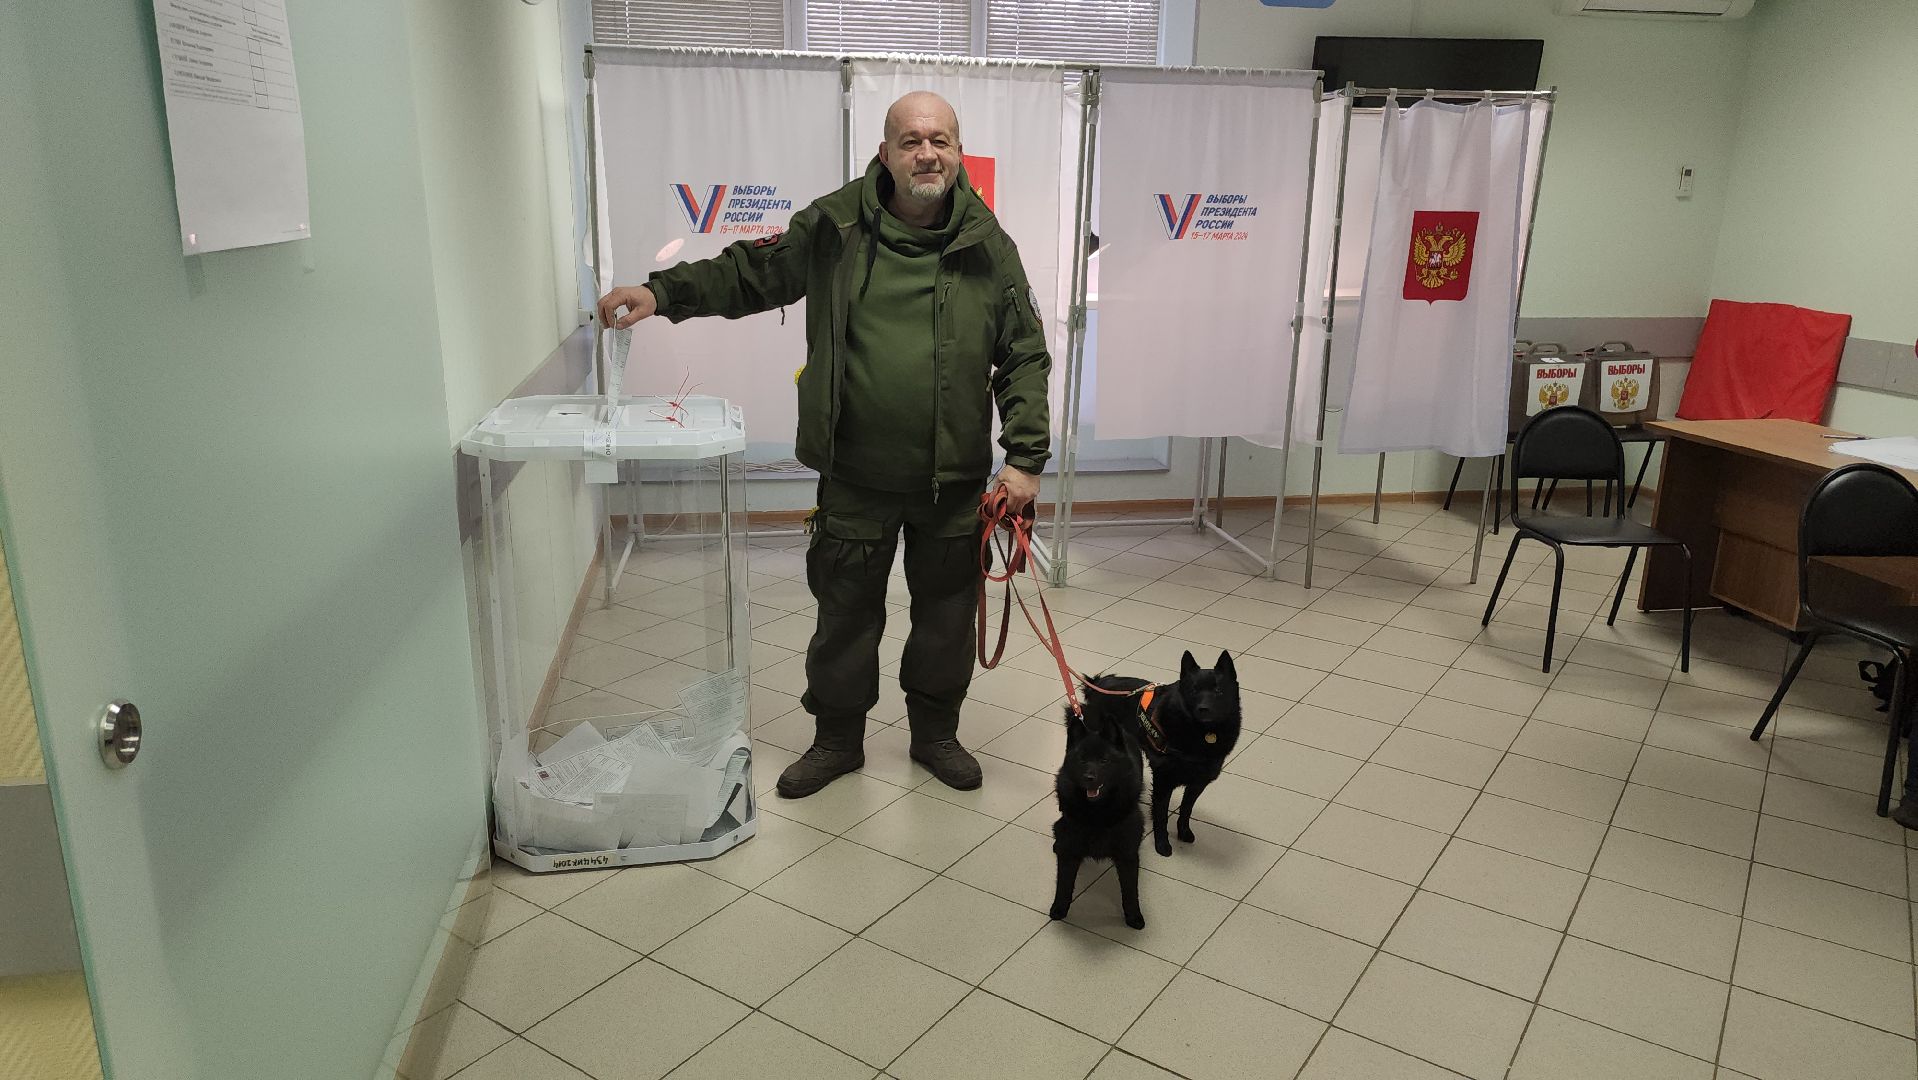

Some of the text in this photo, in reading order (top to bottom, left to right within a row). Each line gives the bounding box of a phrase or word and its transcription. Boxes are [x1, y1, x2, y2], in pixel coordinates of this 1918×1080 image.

[732, 185, 777, 196] ВЫБОРЫ
[728, 199, 792, 210] ПРЕЗИДЕНТА
[1206, 194, 1248, 204] ВЫБОРЫ
[723, 212, 764, 223] РОССИИ
[1200, 207, 1258, 218] ПРЕЗИДЕНТА
[740, 225, 764, 235] МАРТА
[1195, 220, 1234, 229] РОССИИ
[1211, 232, 1233, 240] МАРТА
[1234, 232, 1248, 240] 2024
[1536, 367, 1577, 379] ВЫБОРЫ
[1607, 363, 1646, 375] ВЫБОРЫ
